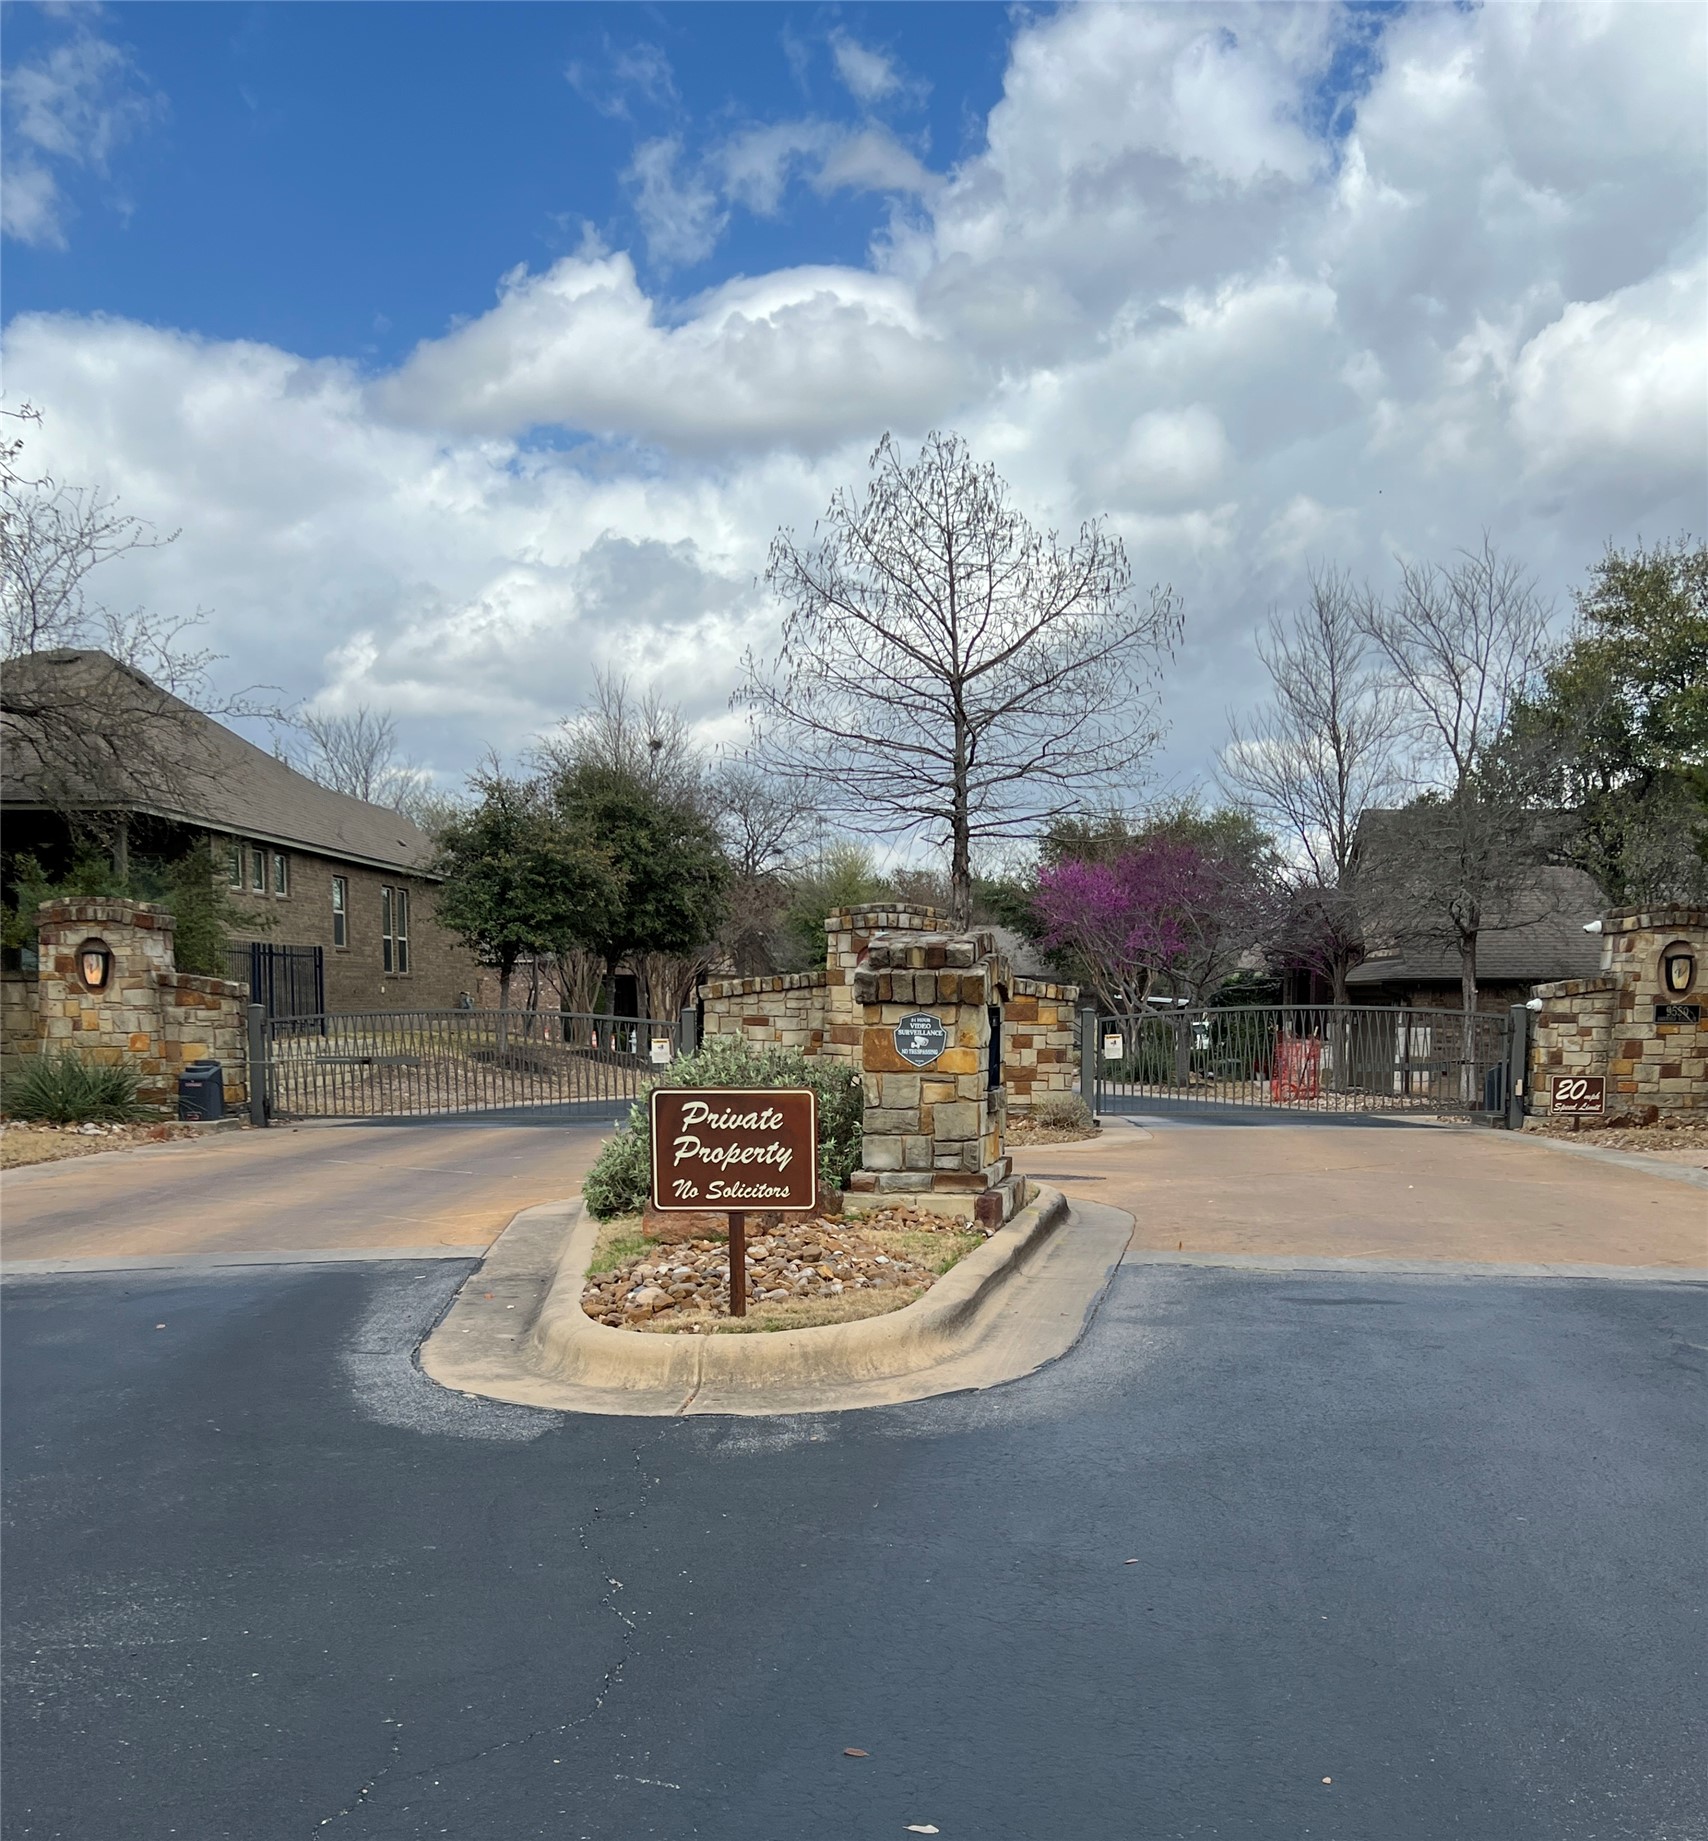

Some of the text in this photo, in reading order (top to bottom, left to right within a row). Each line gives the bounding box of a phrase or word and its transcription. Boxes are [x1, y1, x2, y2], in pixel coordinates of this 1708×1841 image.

[1555, 1079, 1601, 1102] 20 mph
[681, 1101, 784, 1132] Private
[1553, 1102, 1601, 1112] Speed Limit
[673, 1135, 793, 1172] Property
[672, 1179, 791, 1200] No Solicitors
